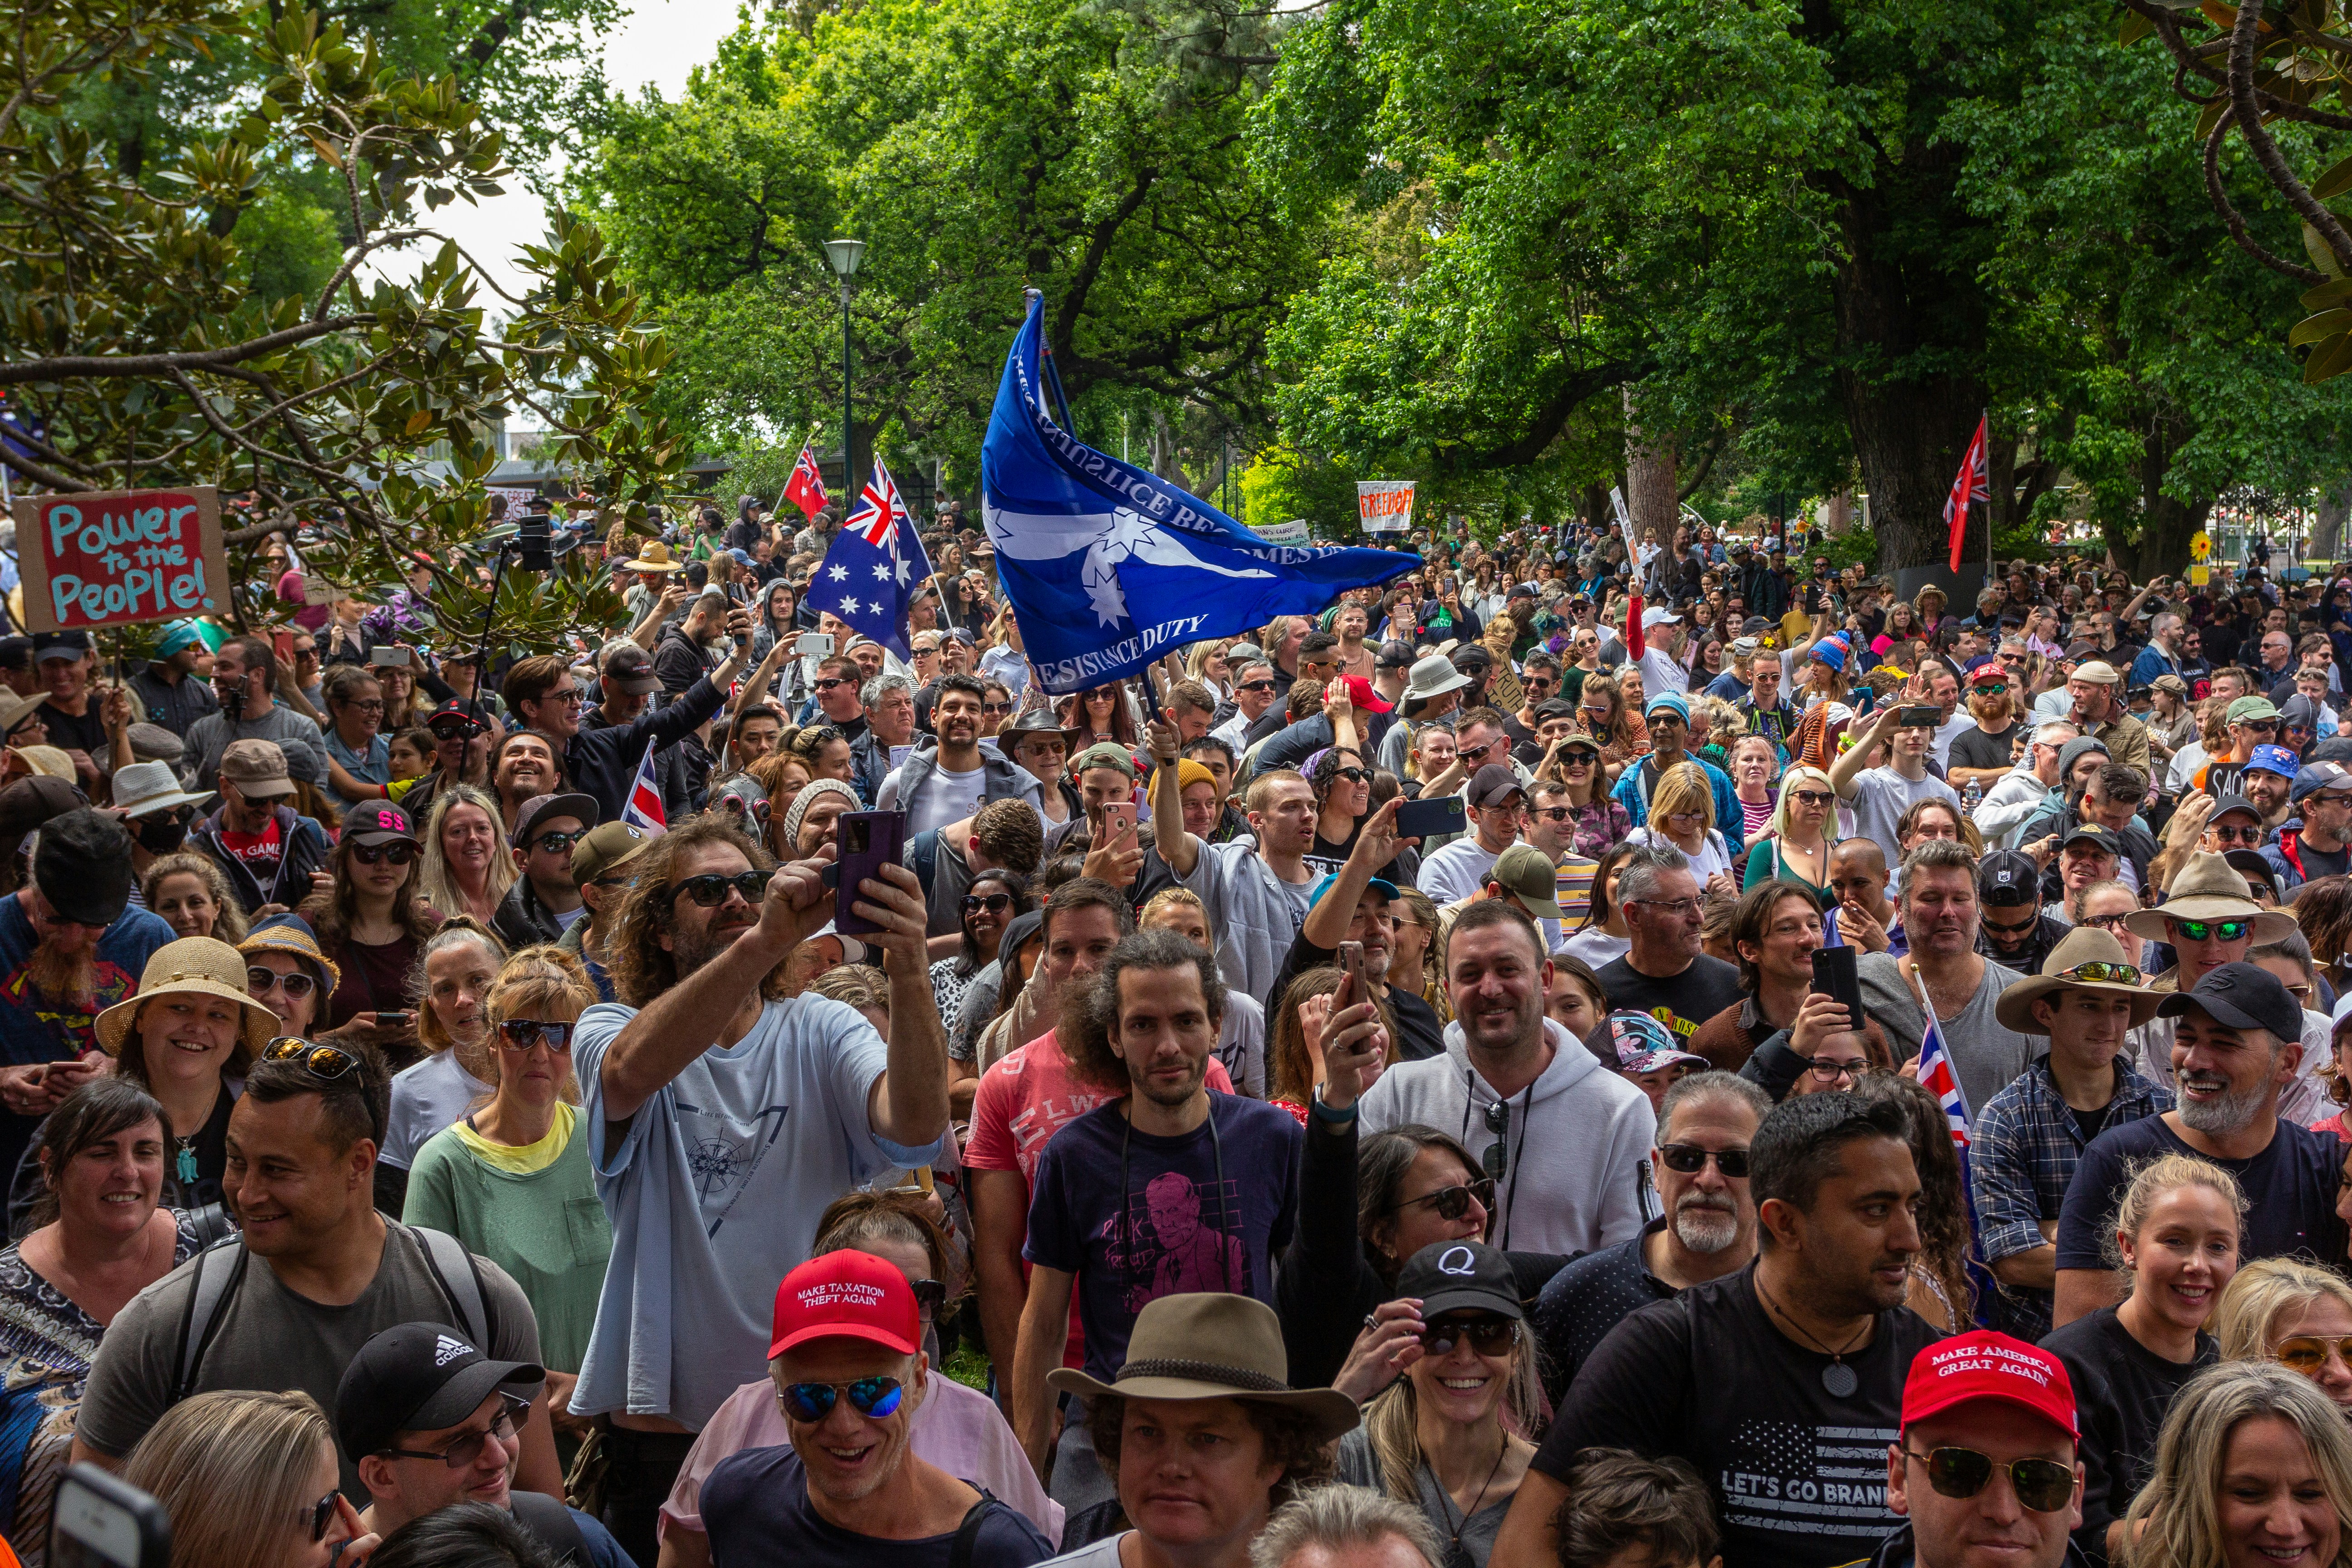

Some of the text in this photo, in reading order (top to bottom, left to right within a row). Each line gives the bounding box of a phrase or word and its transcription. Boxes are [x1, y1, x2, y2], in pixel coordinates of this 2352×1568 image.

[1360, 488, 1413, 518] FREEDOM
[49, 505, 197, 558] Power
[98, 544, 187, 575] to the
[1141, 613, 1209, 652] DUTY
[1497, 661, 1525, 714] TRUTH
[378, 810, 405, 831] SS
[1438, 1246, 1475, 1275] Q
[798, 1283, 884, 1300] MAKE TAXATION
[804, 1294, 877, 1308] THEFT AGAIN
[436, 1343, 474, 1367] adidas
[1931, 1346, 2053, 1377] MAKE AMERICA
[1938, 1359, 2048, 1388] GREAT AGAIN
[1722, 1470, 1889, 1506] LET'S GO BRAN
